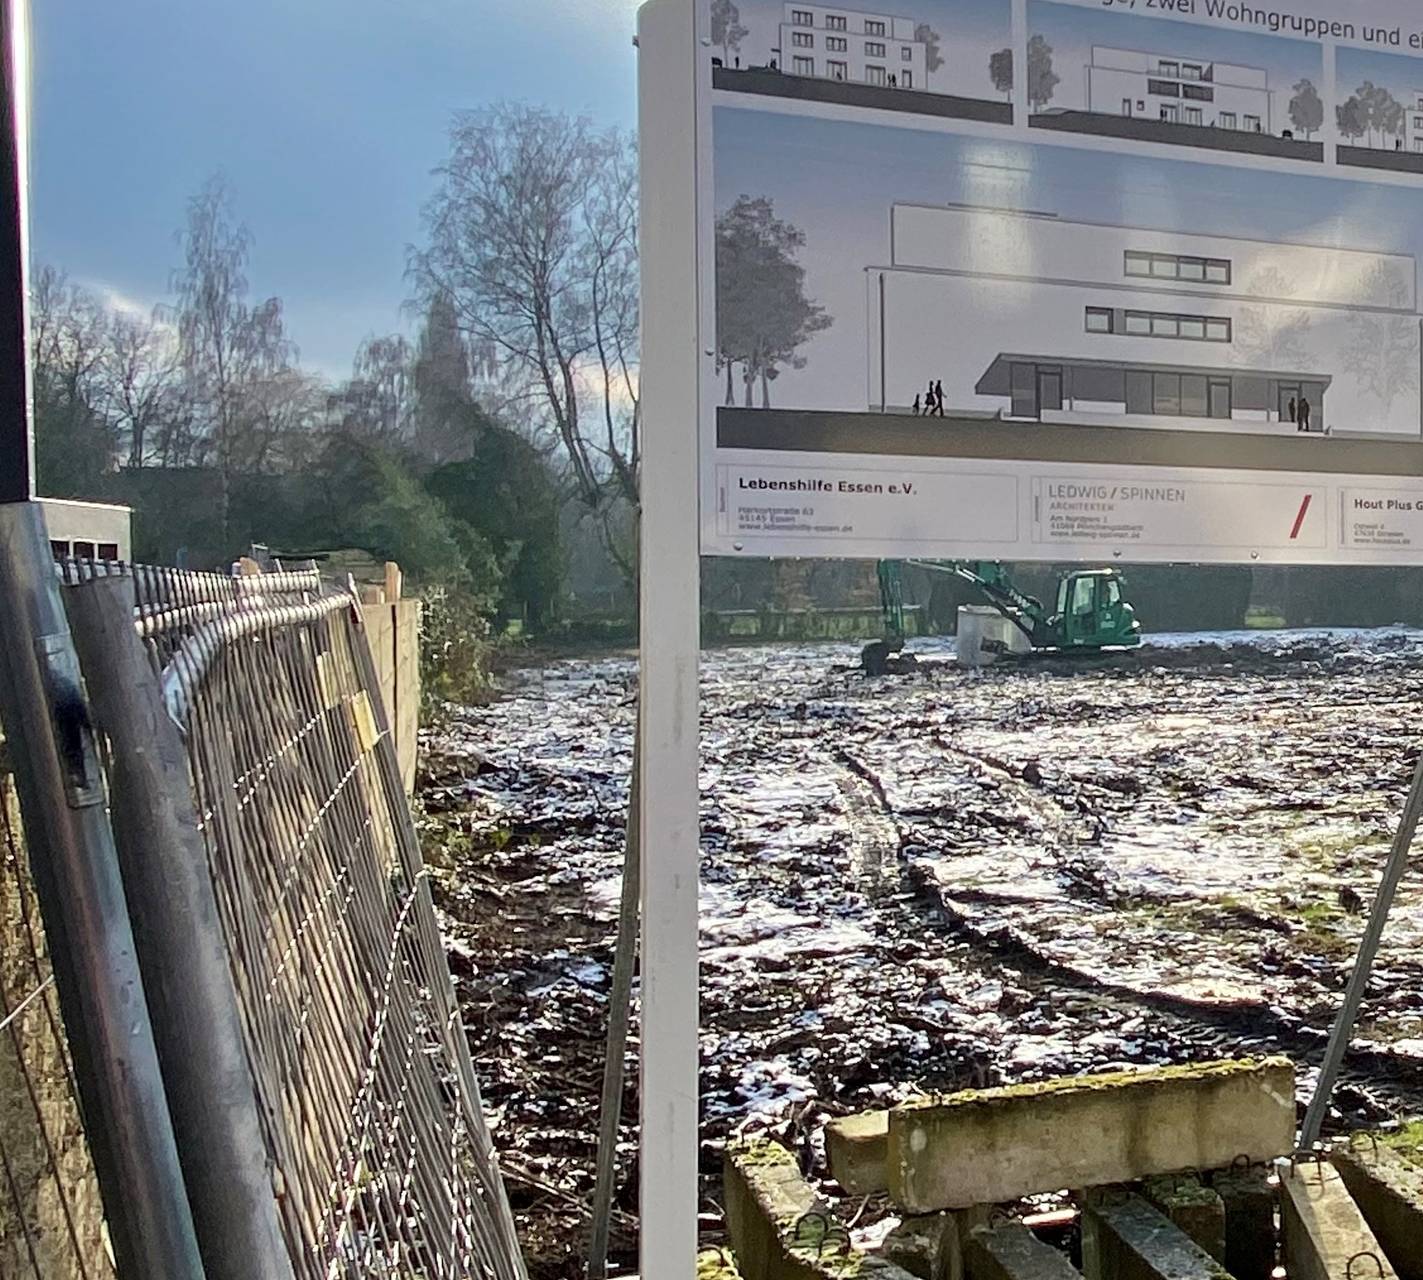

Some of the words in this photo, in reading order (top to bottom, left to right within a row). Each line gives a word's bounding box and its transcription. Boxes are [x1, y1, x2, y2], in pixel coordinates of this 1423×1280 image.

[1206, 0, 1355, 39] Wohngruppen
[1362, 26, 1400, 46] und
[738, 477, 833, 493] Lebenshilfe
[838, 480, 883, 494] Essen
[888, 482, 918, 496] e.V.
[1048, 484, 1107, 499] LEDWIG
[1120, 487, 1185, 502] SPINNEN
[1354, 498, 1383, 510] Hout
[1386, 499, 1412, 511] Plus
